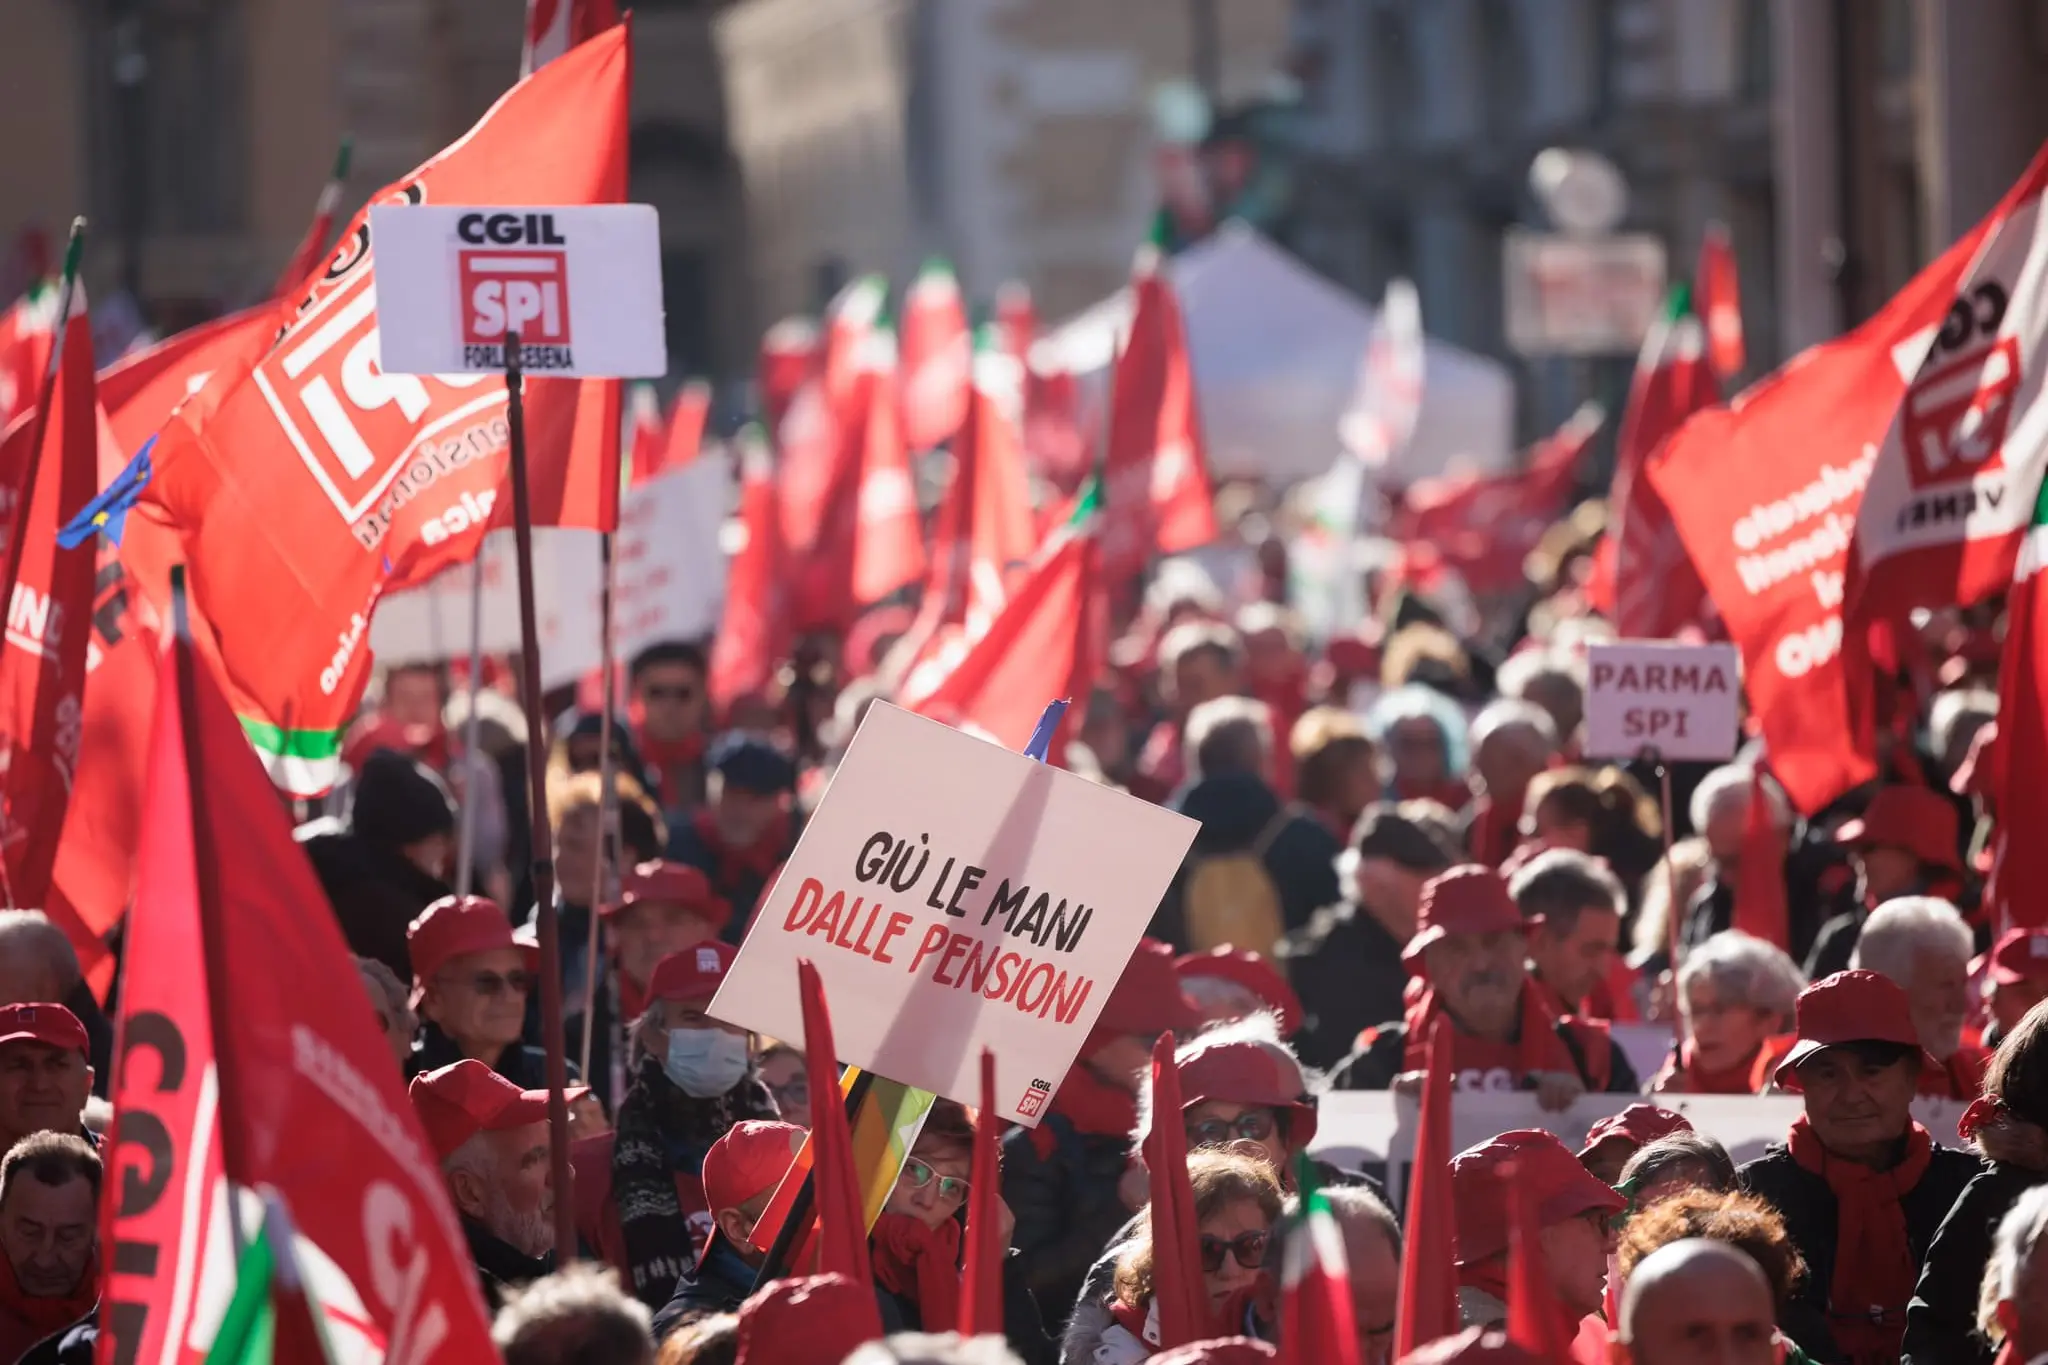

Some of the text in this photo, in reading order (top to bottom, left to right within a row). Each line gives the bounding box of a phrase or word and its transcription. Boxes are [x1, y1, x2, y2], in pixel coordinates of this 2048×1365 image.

[457, 213, 565, 245] CGIL
[472, 280, 561, 338] SPI
[1592, 663, 1728, 694] PARMA
[1624, 707, 1688, 738] SPI
[855, 831, 1094, 953] GIÙ LE MANI
[782, 877, 1094, 1024] DALLE PENSIONI
[1031, 1078, 1051, 1092] CGIL
[1019, 1095, 1044, 1116] SPI
